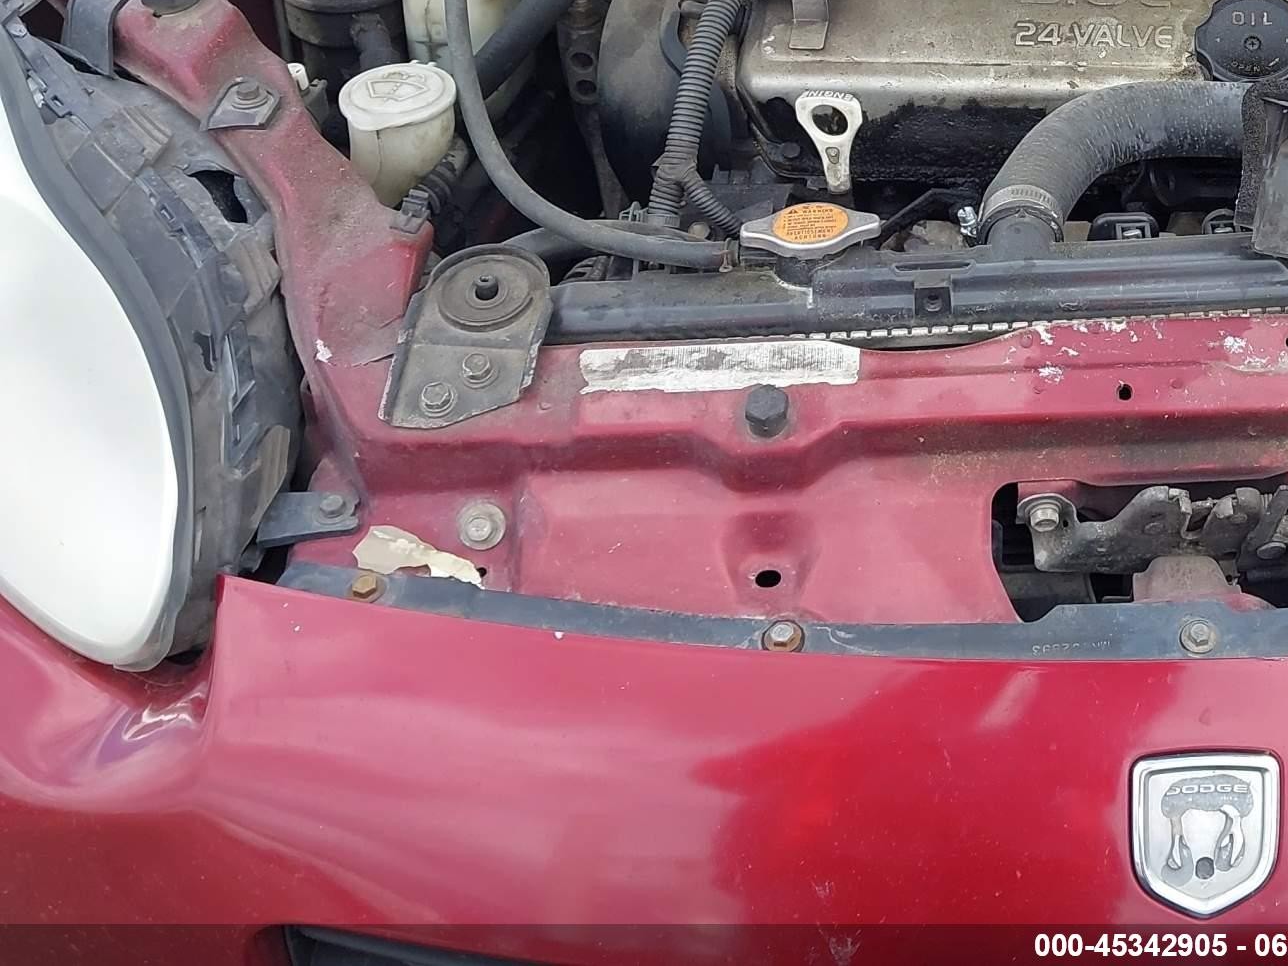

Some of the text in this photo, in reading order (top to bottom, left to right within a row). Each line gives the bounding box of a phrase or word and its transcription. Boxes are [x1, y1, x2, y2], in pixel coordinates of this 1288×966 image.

[1231, 11, 1273, 26] OIL
[1015, 22, 1173, 48] 24 VALVE
[1230, 58, 1261, 72] OPEN
[800, 89, 854, 102] ENGINE
[1166, 784, 1250, 795] DODGE
